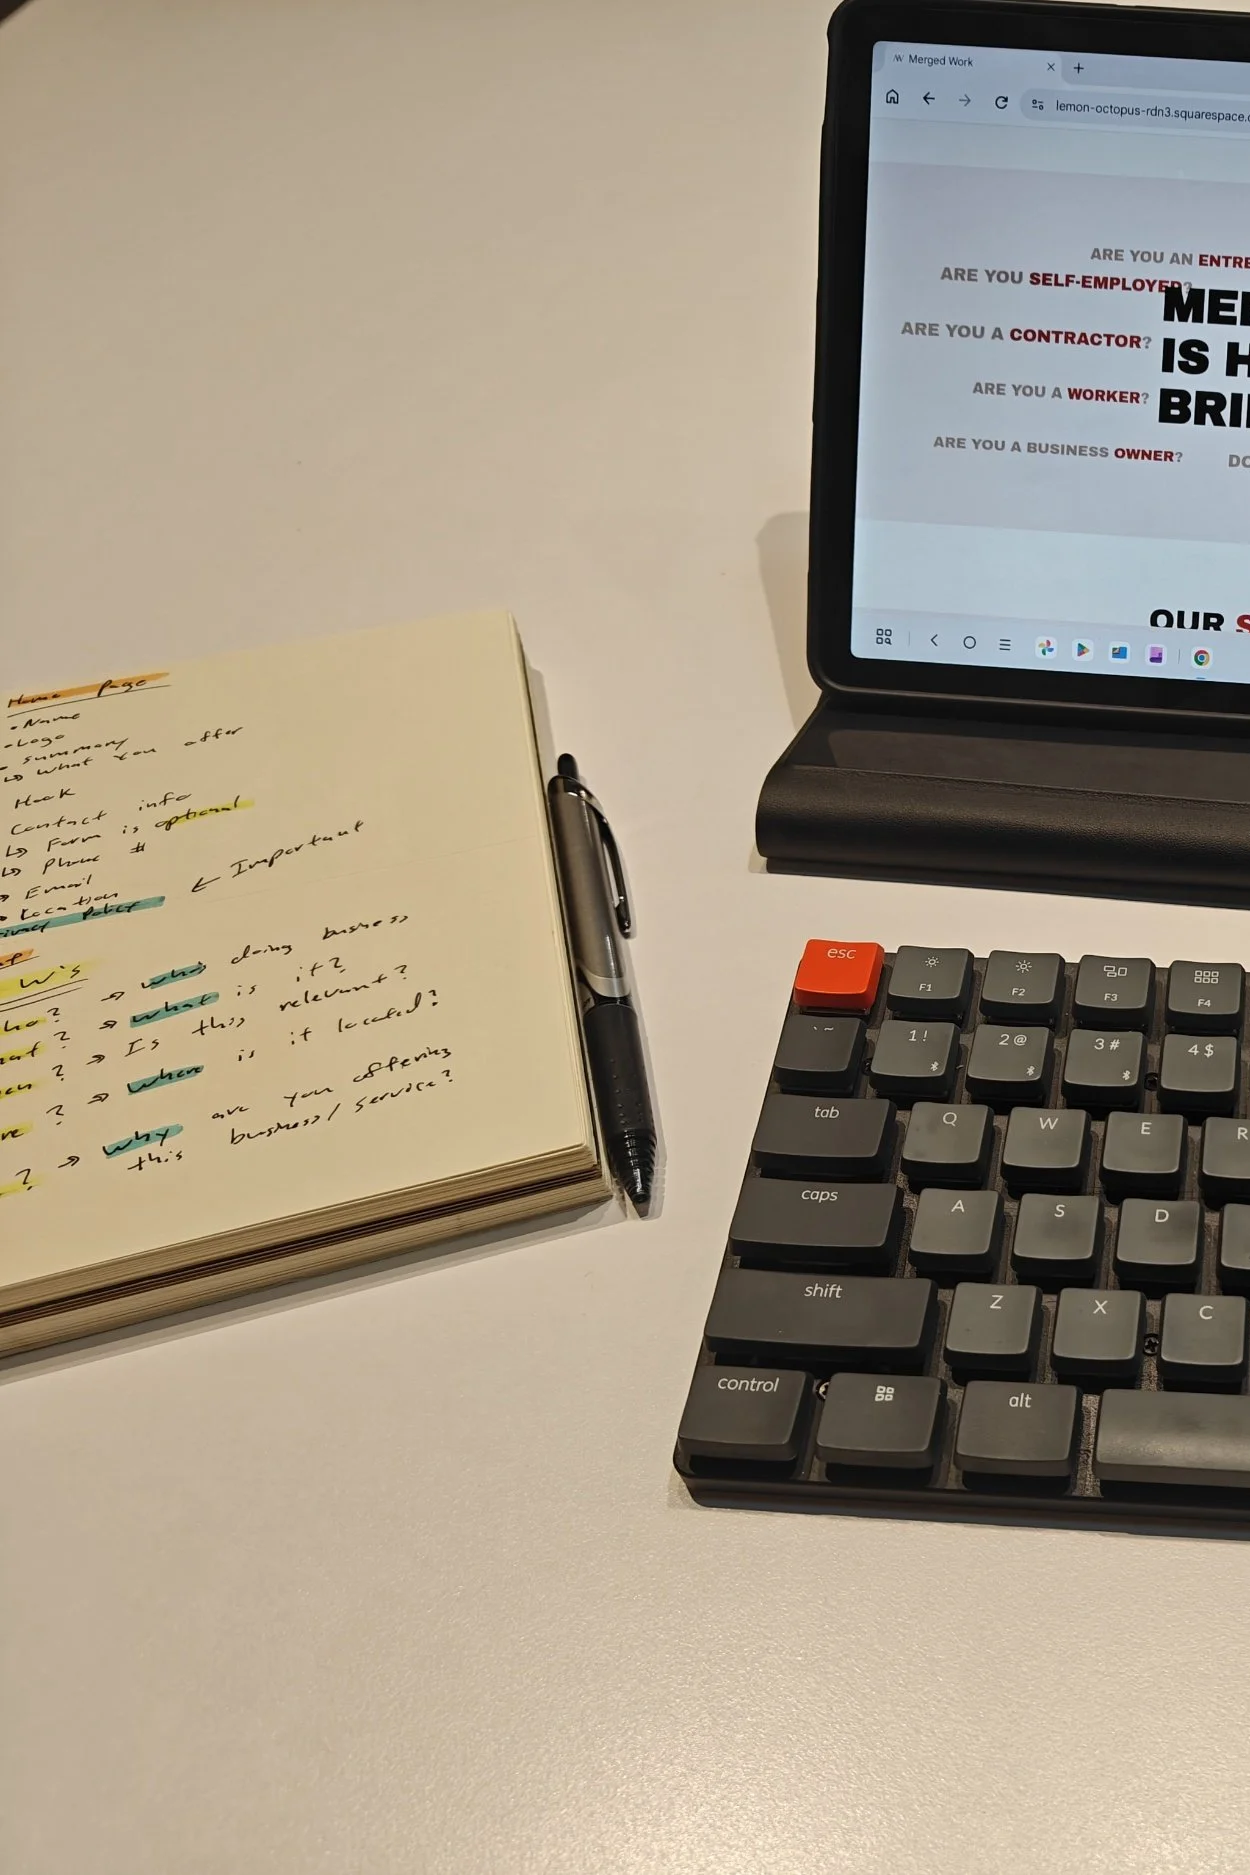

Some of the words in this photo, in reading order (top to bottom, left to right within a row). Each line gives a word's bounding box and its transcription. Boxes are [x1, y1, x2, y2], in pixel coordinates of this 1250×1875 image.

[908, 53, 946, 68] Merged
[948, 56, 973, 67] Work
[1090, 247, 1125, 262] ARE
[1129, 249, 1165, 264] YOU
[1169, 252, 1194, 266] AN
[940, 266, 979, 283] ARE
[984, 269, 1024, 285] YOU
[900, 321, 940, 337] ARE
[945, 323, 985, 339] YOU
[991, 326, 1004, 341] A
[1009, 328, 1152, 349] CONTRACTOR?
[1161, 337, 1210, 375] IS
[972, 381, 1007, 396] ARE
[1011, 383, 1046, 398] YOU
[1050, 386, 1063, 400] A
[1067, 387, 1149, 404] WORKER?
[933, 436, 967, 449] ARE
[971, 438, 1006, 451] YOU
[1010, 441, 1022, 453] A
[1026, 441, 1109, 458] BUSINESS
[1114, 447, 1183, 463] OWNER?
[1150, 609, 1225, 631] OUR
[23, 713, 80, 729] Name
[155, 796, 240, 831] optional
[231, 820, 364, 878] Important
[25, 874, 92, 900] Email
[827, 948, 857, 960] esc
[919, 983, 932, 992] F1
[1011, 987, 1026, 997] F2
[1103, 993, 1118, 1002] F3
[1197, 998, 1211, 1008] F4
[814, 1106, 840, 1119] tab
[942, 1111, 958, 1127] Q
[1039, 1117, 1059, 1130] W
[1140, 1121, 1152, 1135] E
[1237, 1126, 1249, 1141] R
[801, 1189, 839, 1204] caps
[951, 1199, 965, 1213] A
[1054, 1204, 1066, 1218] S
[1154, 1208, 1170, 1223] D
[803, 1283, 843, 1299] shift
[717, 1377, 780, 1393] control
[1008, 1392, 1032, 1408] alt
